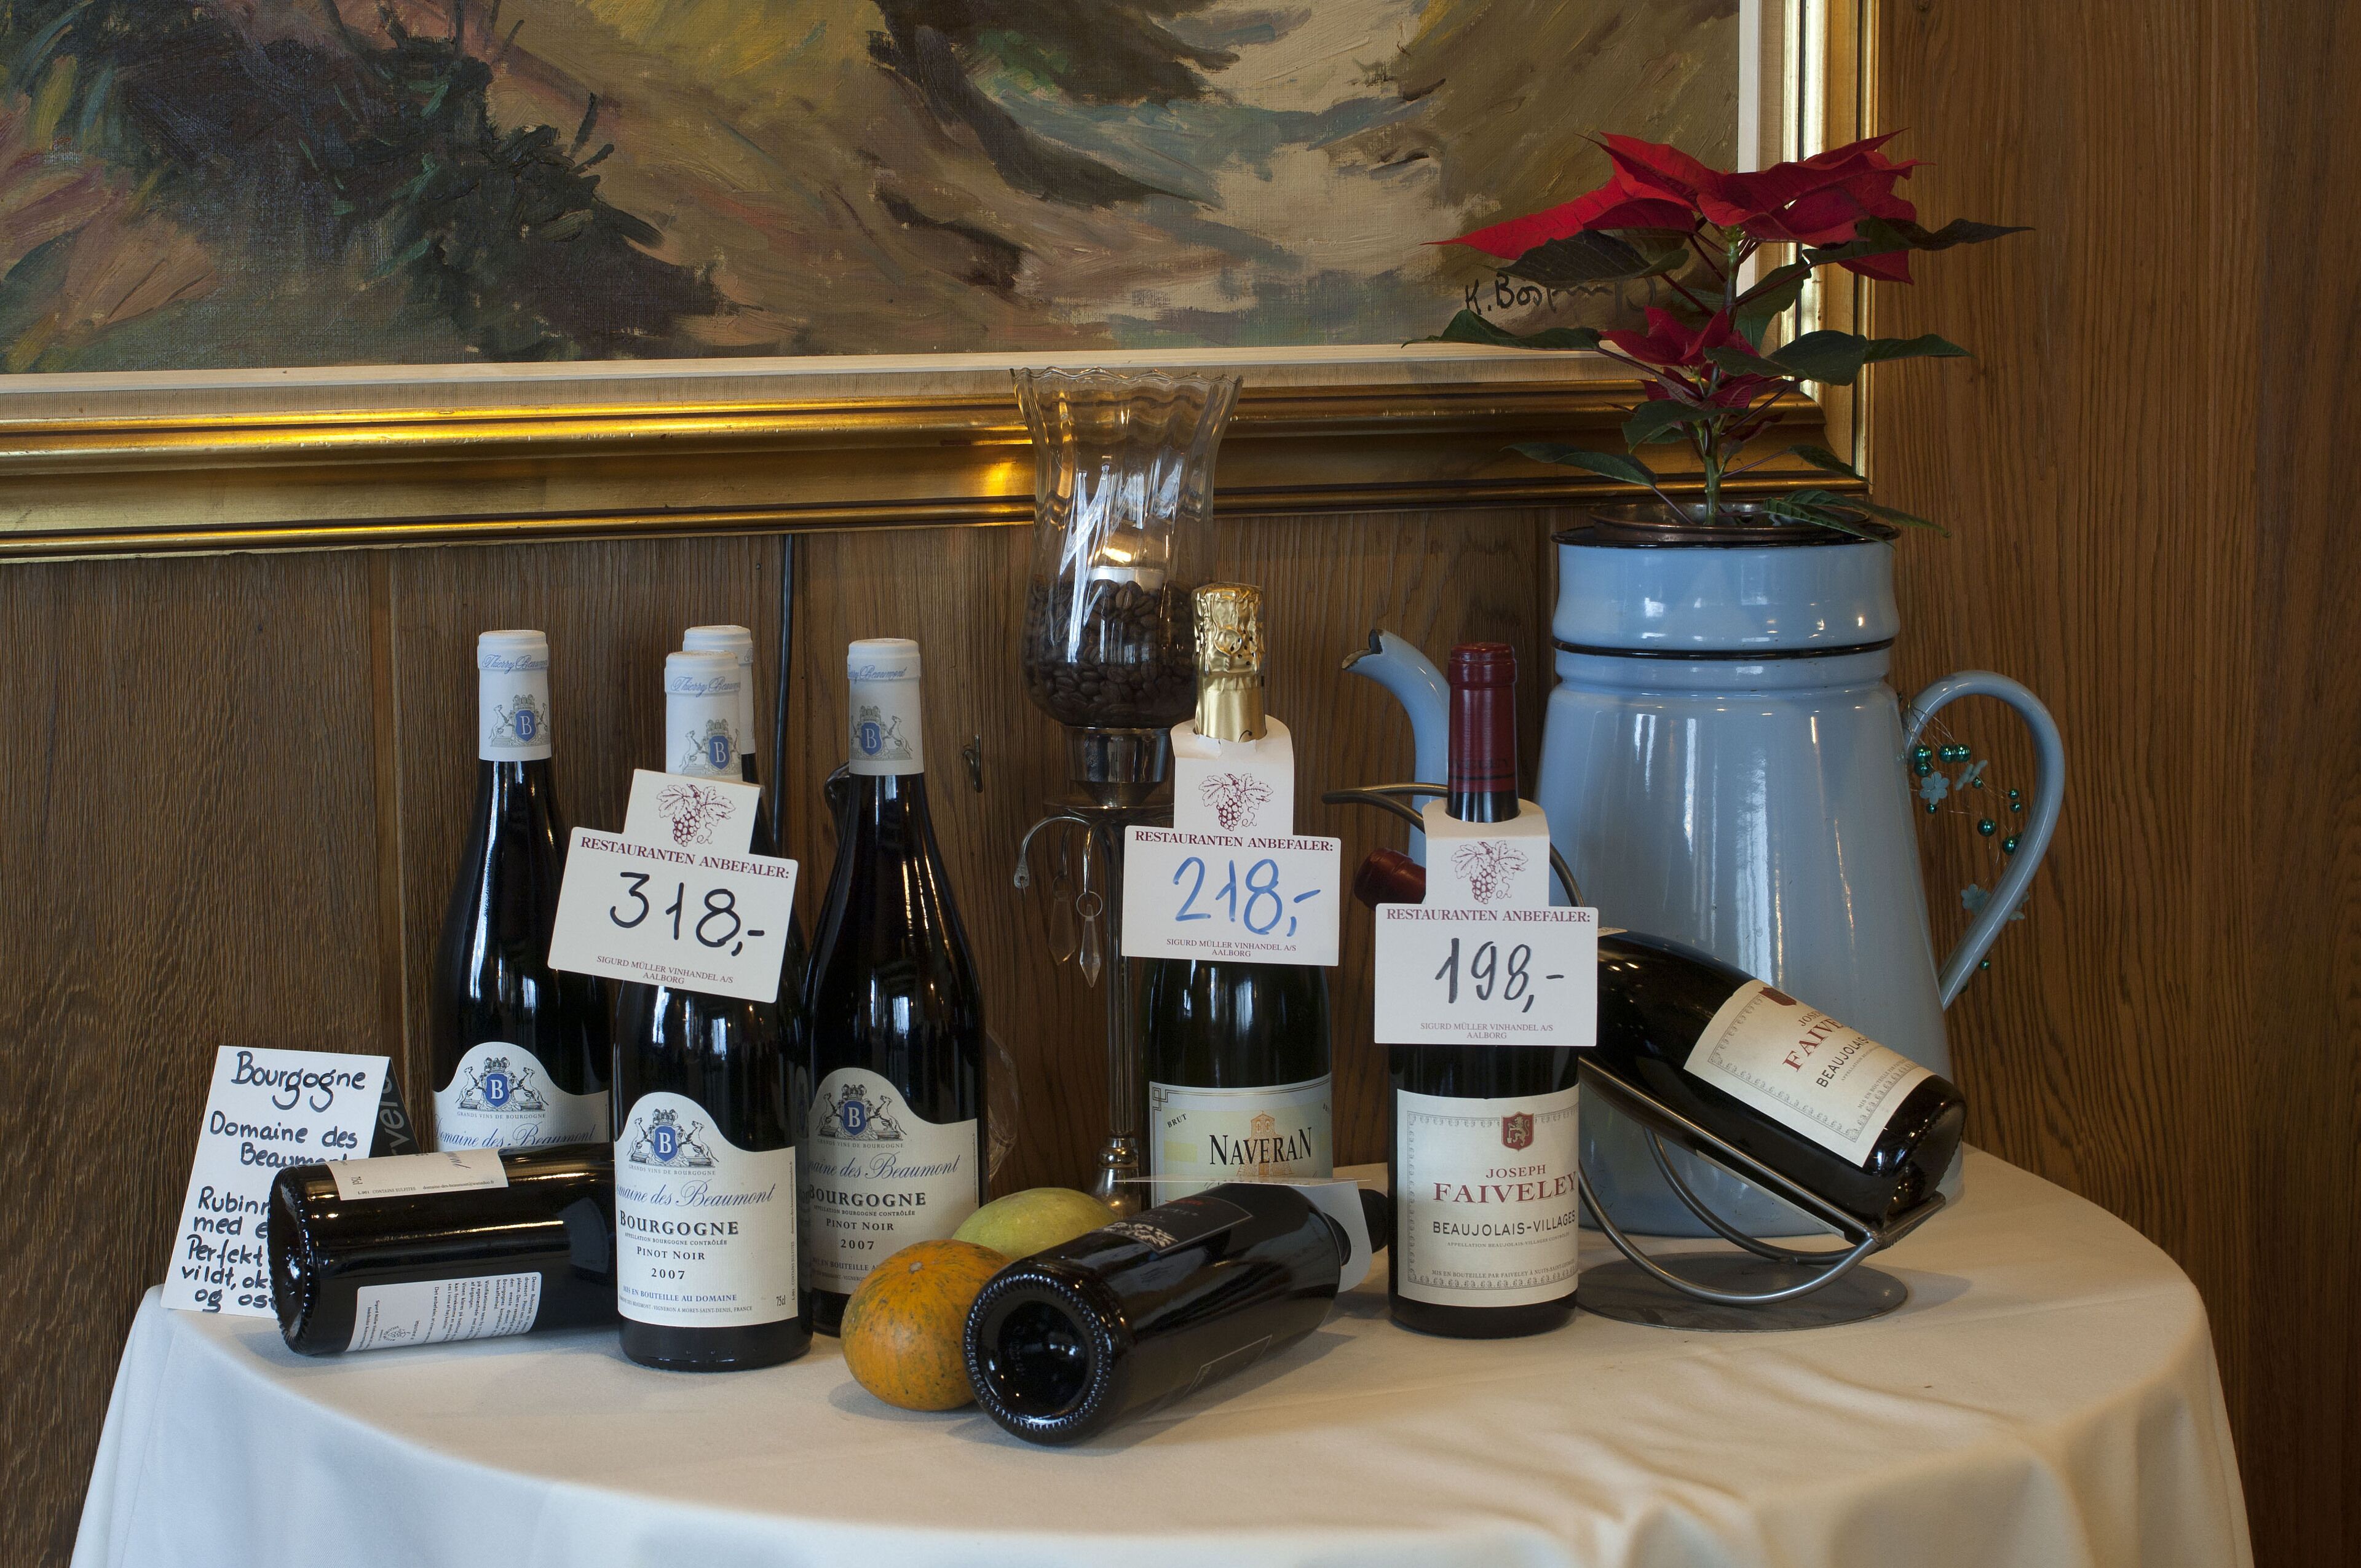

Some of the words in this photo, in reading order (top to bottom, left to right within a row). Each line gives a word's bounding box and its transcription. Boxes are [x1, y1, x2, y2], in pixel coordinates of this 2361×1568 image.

[520, 715, 532, 735] B
[865, 728, 877, 749] B
[713, 741, 727, 764] B
[1135, 830, 1243, 847] RESTAURANTEN
[1248, 837, 1334, 852] ANBEFALER:
[580, 836, 696, 866] RESTAURANTEN
[698, 855, 790, 879] ANBEFALER:
[1173, 856, 1321, 937] 218,-
[609, 871, 765, 957] 318,-
[1386, 908, 1498, 922] RESTAURANTEN
[1502, 910, 1591, 923] ANBEFALER:
[1166, 938, 1197, 947] SIGURD
[1199, 940, 1233, 949] MÜLLER
[1234, 942, 1283, 951] VINHANDEL
[1211, 949, 1251, 958] AALBORG
[596, 955, 630, 968] SIGURD
[631, 960, 666, 973] MÜLLER
[668, 967, 719, 982] VINHANDEL
[720, 975, 734, 984] A/S
[643, 972, 685, 984] AALBORG
[1434, 937, 1565, 1013] 198,-
[1453, 1021, 1489, 1031] MÜLLER
[1490, 1023, 1539, 1032] VINHANDEL
[1798, 1010, 1822, 1027] JOSE
[1466, 1031, 1508, 1040] AALBORG
[1782, 1018, 1844, 1073] FAIVE
[231, 1050, 366, 1113] Bourgogne
[490, 1079, 504, 1099] B
[848, 1106, 861, 1128] B
[1167, 1113, 1187, 1128] BRUT
[210, 1110, 308, 1144] Domaine
[322, 1125, 358, 1149] des
[481, 1128, 504, 1148] des
[658, 1132, 672, 1154] B
[1209, 1127, 1312, 1166] NAVERAN
[240, 1141, 348, 1170] Beaum
[840, 1157, 861, 1179] des
[865, 1151, 961, 1179] Beaumont
[1485, 1164, 1546, 1179] JOSEPH
[651, 1184, 673, 1205] des
[676, 1178, 777, 1207] Beaumont
[809, 1184, 927, 1208] BOURGOGNE
[1433, 1170, 1578, 1203] FAIVELEY
[194, 1216, 243, 1236] med
[255, 1221, 267, 1239] e
[620, 1210, 740, 1237] BOURGOGNE
[826, 1218, 858, 1230] PINOT
[862, 1222, 894, 1230] NOIR
[1433, 1210, 1576, 1237] BEAUJOLAIS-VILLAGES
[186, 1233, 263, 1269] Perfekt
[636, 1246, 668, 1259] PINOT
[673, 1251, 706, 1260] NOIR
[840, 1238, 875, 1250] 2007
[651, 1268, 686, 1280] 2007
[830, 1261, 869, 1272] BOUTEILLE
[242, 1269, 269, 1289] ok
[194, 1288, 223, 1313] og
[641, 1291, 679, 1302] BOUTEILLE
[776, 1295, 786, 1307] 75cl
